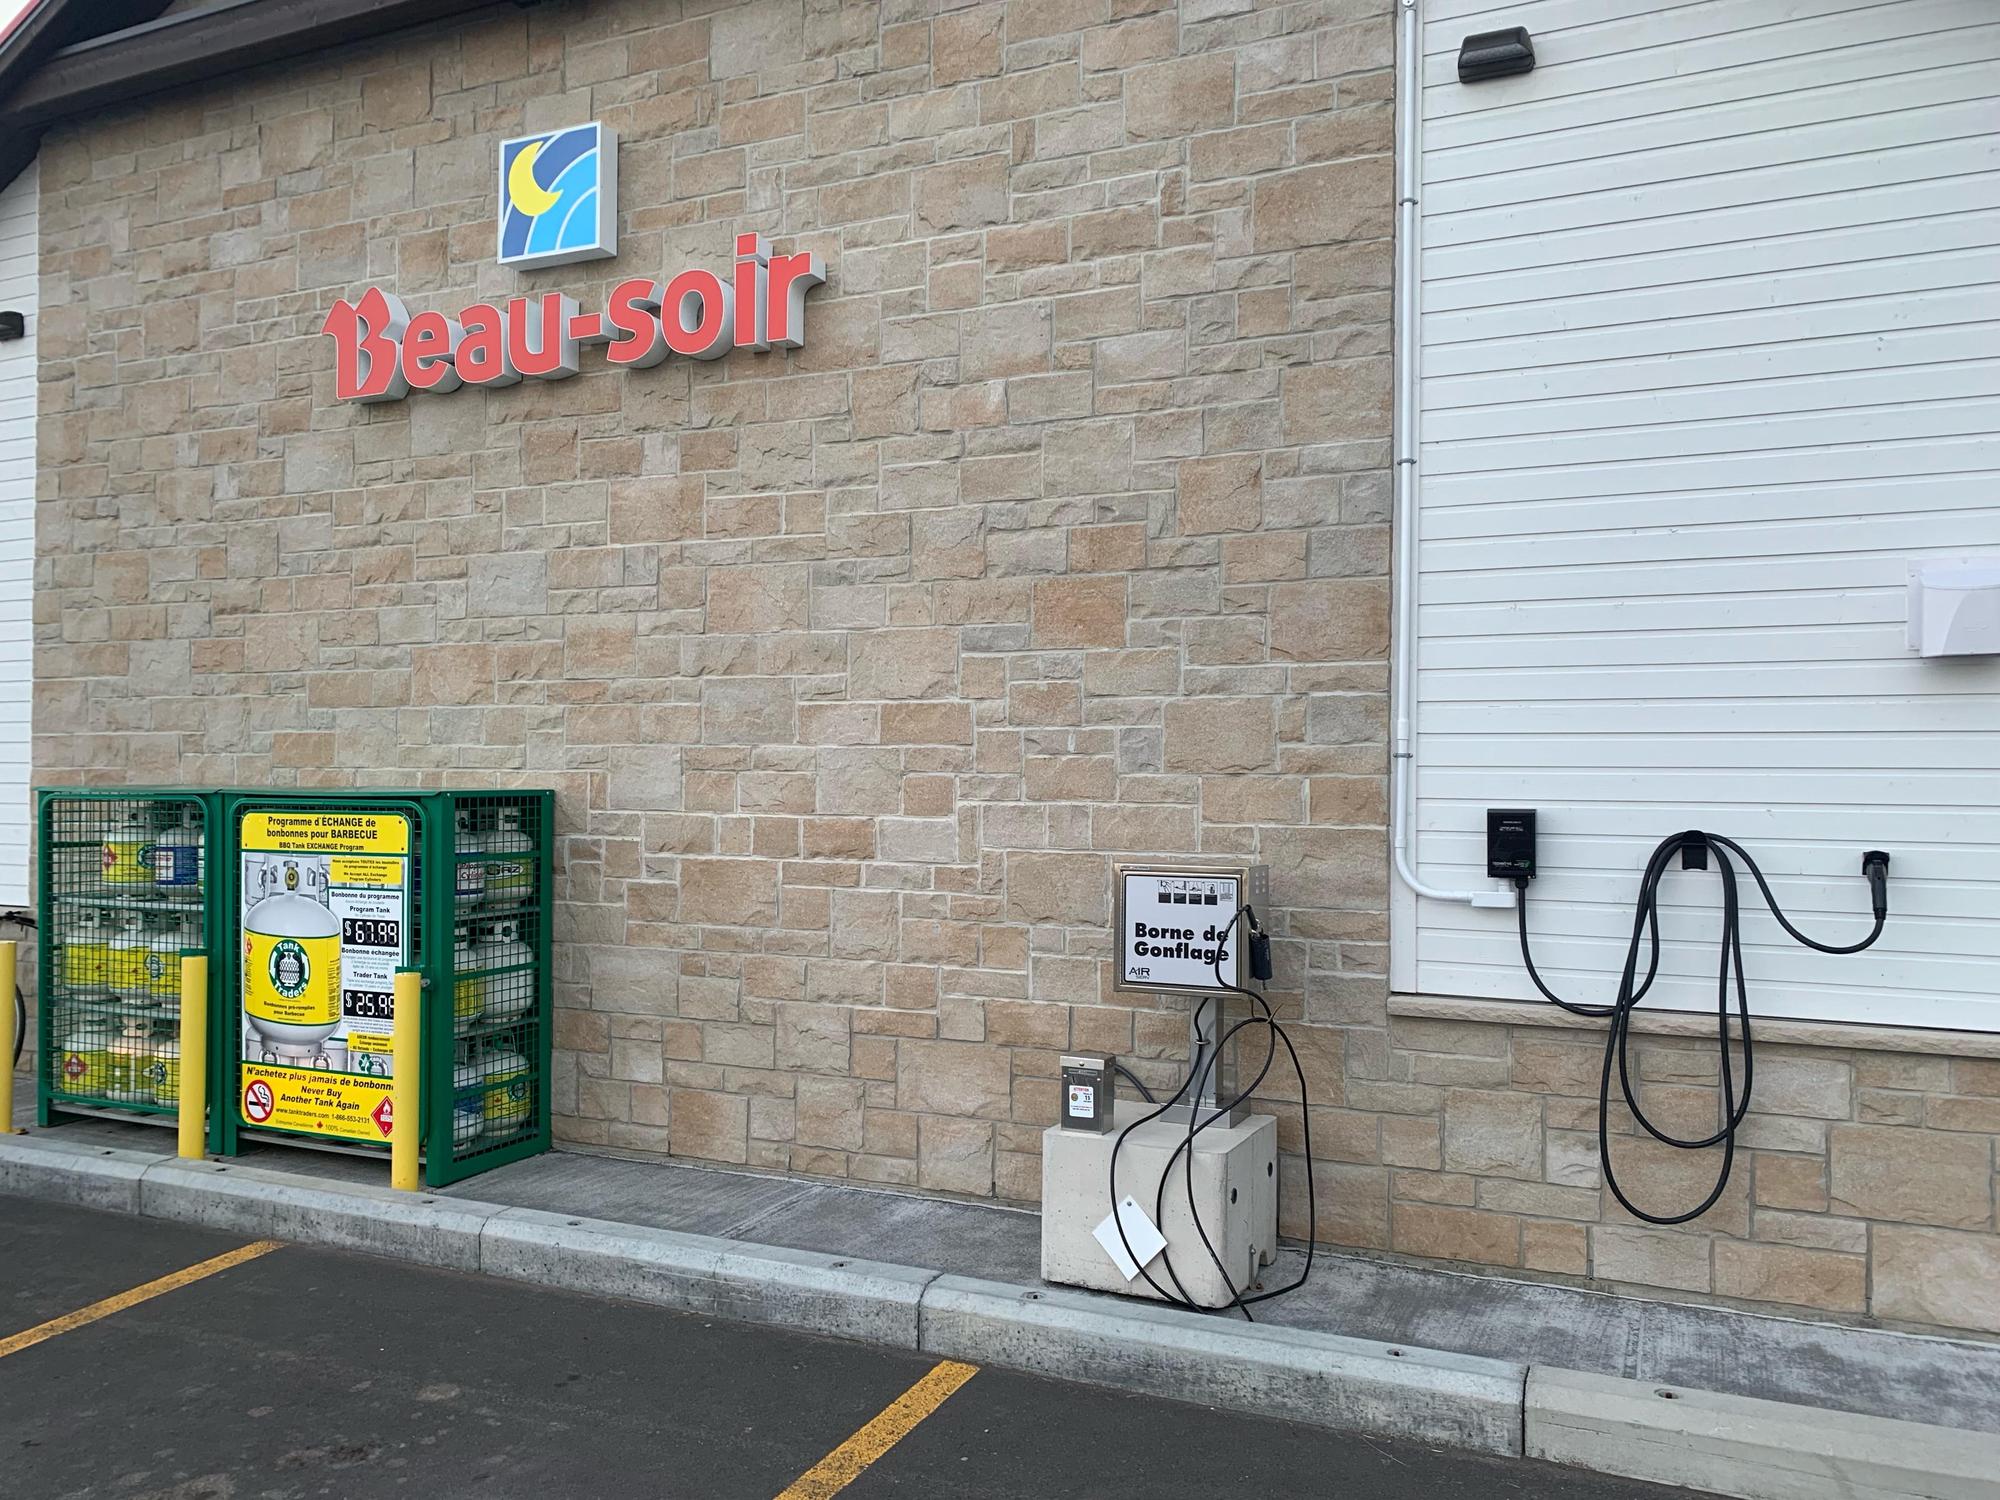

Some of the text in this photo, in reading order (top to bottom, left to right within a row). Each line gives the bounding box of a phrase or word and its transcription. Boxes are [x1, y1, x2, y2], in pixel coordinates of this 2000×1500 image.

[321, 232, 826, 402] Beau-soir
[268, 815, 376, 828] Programme d'ÉCHANGE de
[267, 828, 377, 840] bonbonnes pour BARBECUE
[340, 843, 364, 851] Program
[350, 905, 374, 913] Program
[355, 921, 397, 944] 67.99
[1135, 922, 1229, 942] Borne de
[277, 942, 300, 952] Tank
[342, 947, 399, 957] Bonbonne échangée
[1134, 941, 1229, 965] Gonflage
[274, 980, 307, 998] Traders
[247, 1066, 287, 1079] N'achetez
[289, 1072, 307, 1082] plus
[308, 1073, 337, 1085] jamais
[340, 1077, 351, 1086] de
[301, 1086, 342, 1099] Never Buy
[280, 1094, 360, 1111] Another Tank Again
[276, 1107, 329, 1119] www.tanktraders.com
